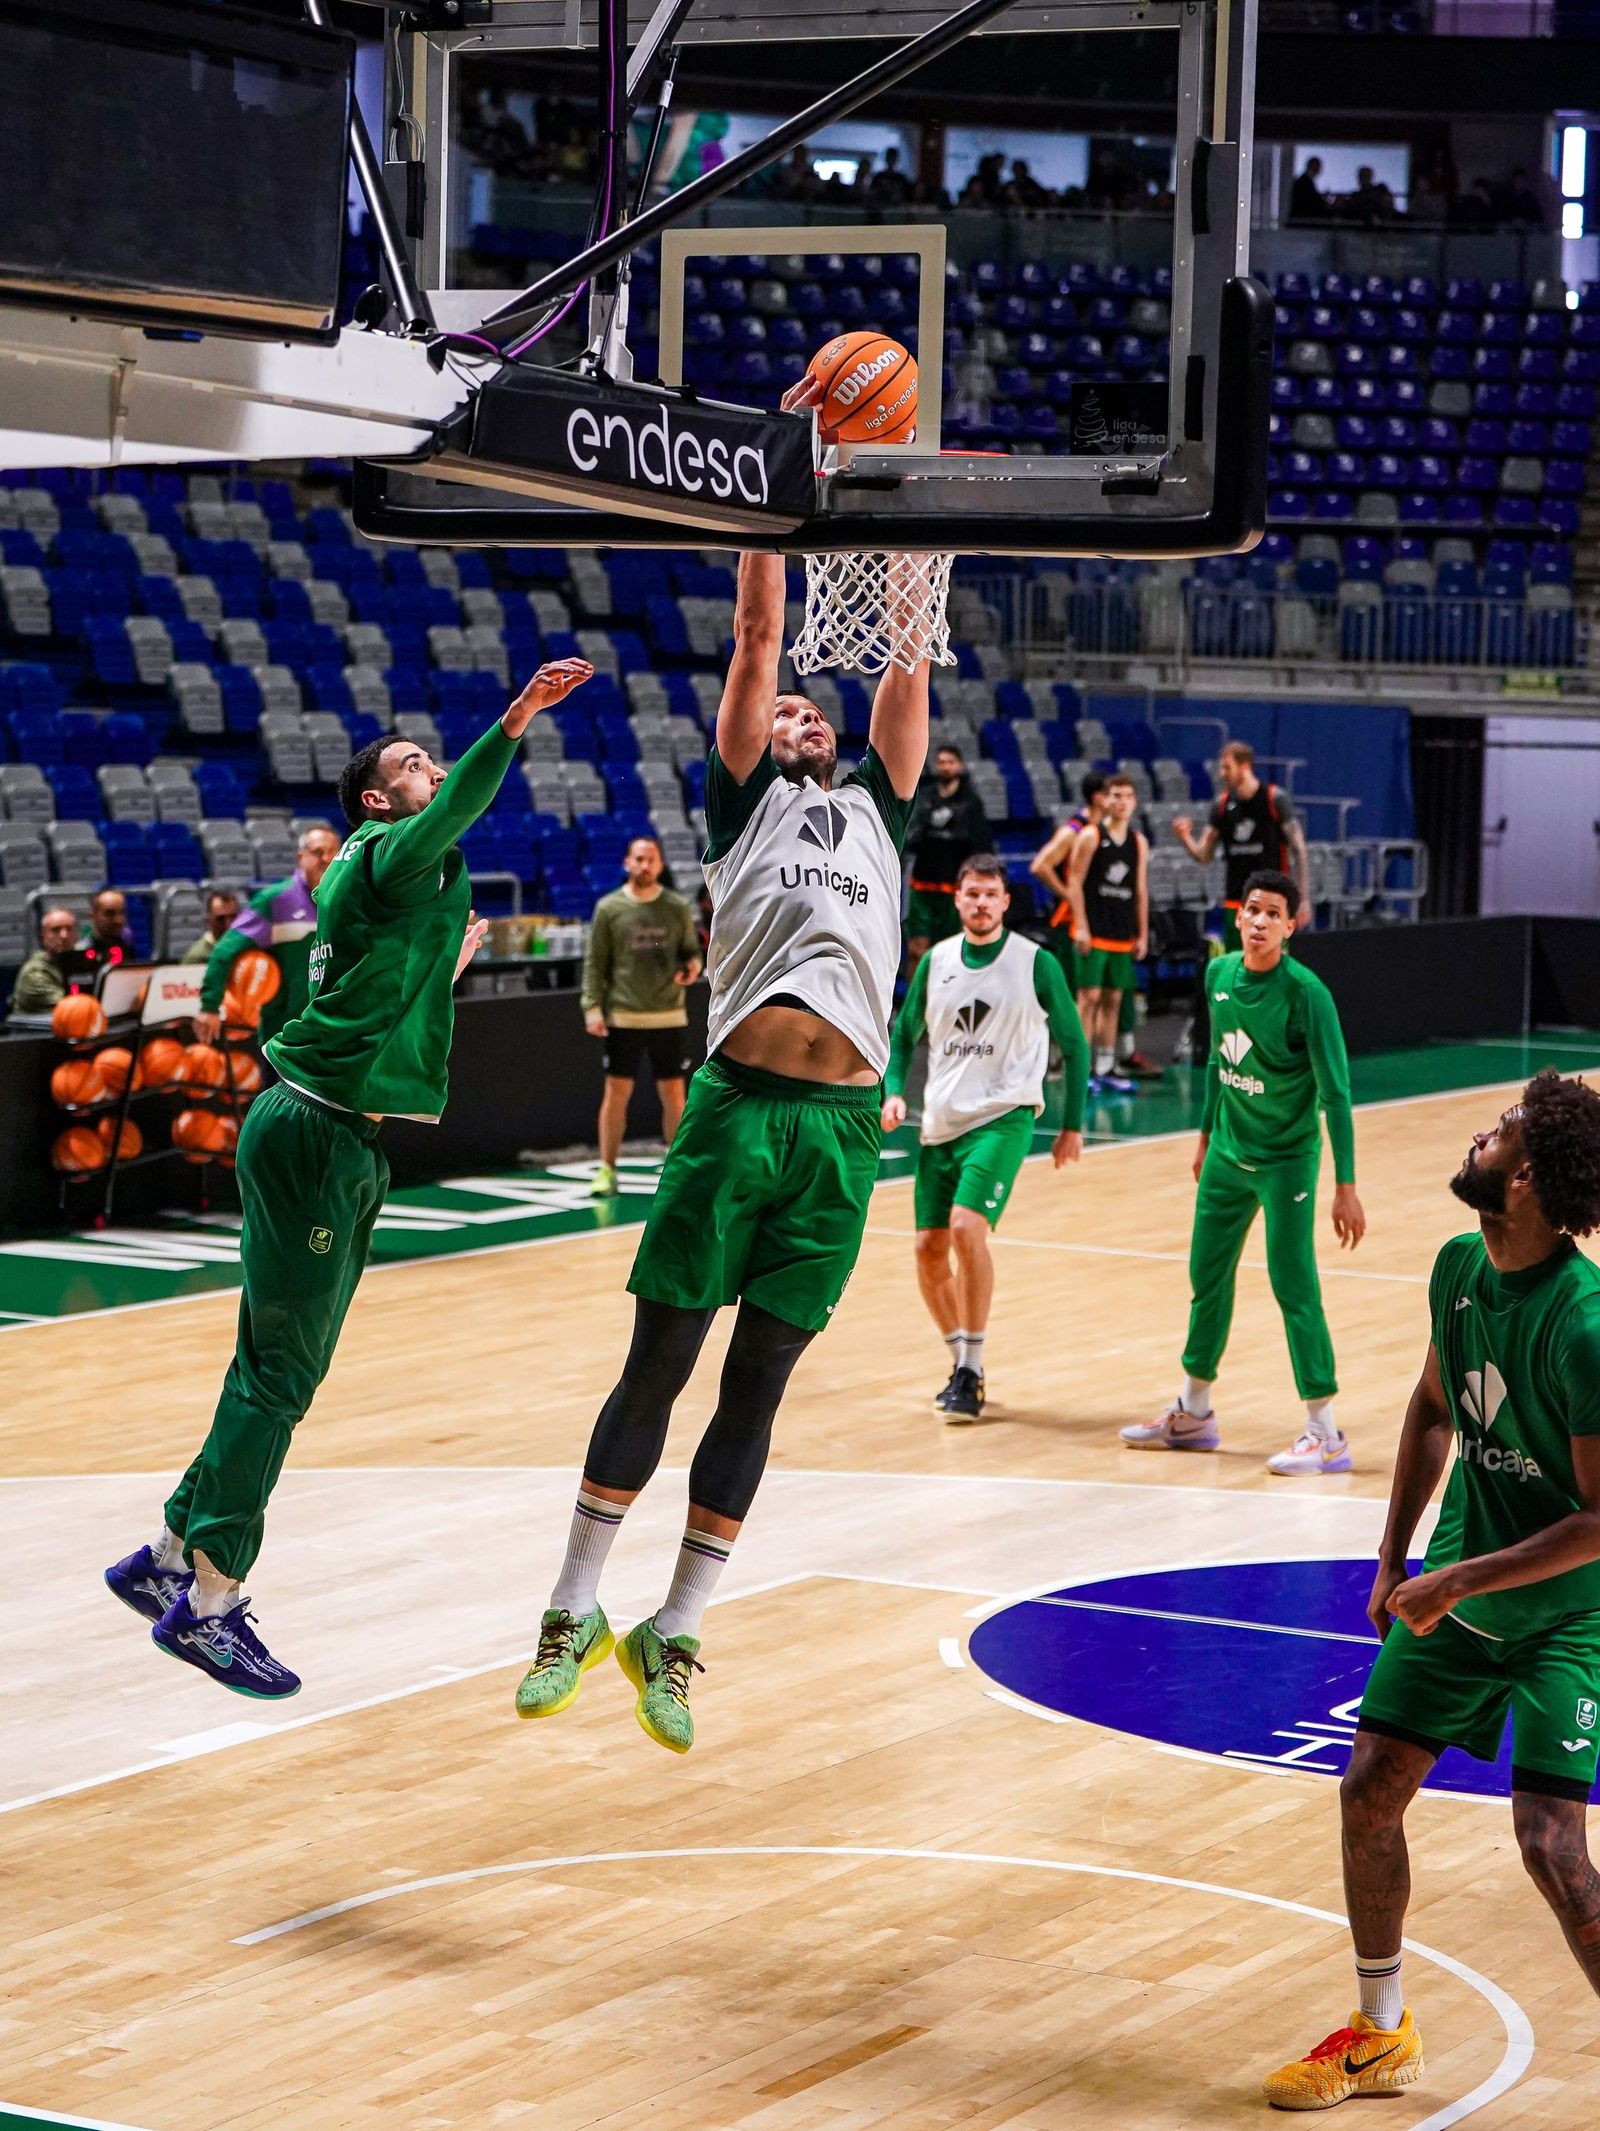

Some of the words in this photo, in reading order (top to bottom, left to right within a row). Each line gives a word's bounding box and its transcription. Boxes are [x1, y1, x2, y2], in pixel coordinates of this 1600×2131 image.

[832, 348, 900, 406] Wilson
[865, 413, 888, 430] liga
[887, 378, 917, 415] endesa
[1113, 418, 1137, 432] liga
[567, 403, 769, 505] endesa
[1112, 432, 1166, 444] endesa
[780, 863, 868, 906] Unicaja
[1218, 1067, 1265, 1096] nicaja
